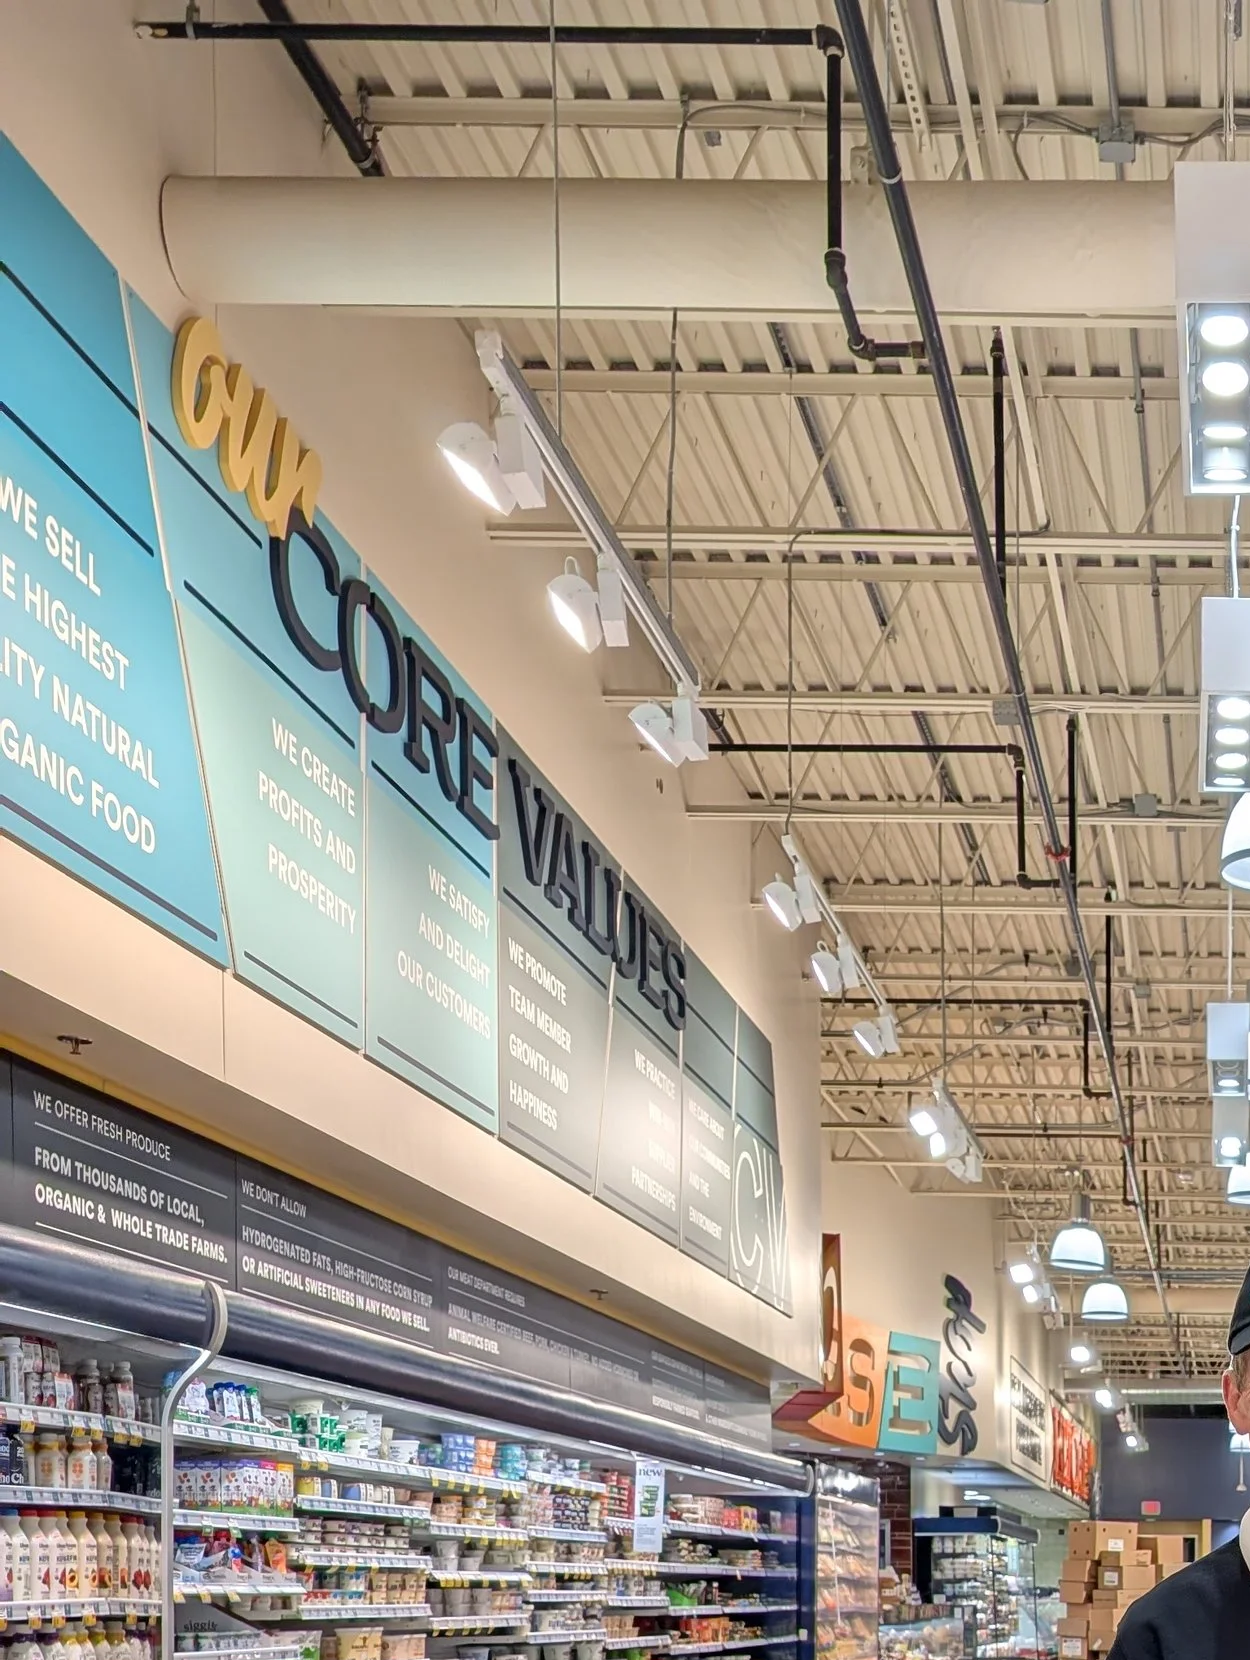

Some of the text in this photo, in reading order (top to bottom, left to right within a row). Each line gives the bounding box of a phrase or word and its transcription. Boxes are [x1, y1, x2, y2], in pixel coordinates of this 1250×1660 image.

[0, 476, 101, 597] WE SELL
[24, 573, 129, 691] HIGHEST
[0, 636, 160, 789] ITY NATURAL
[269, 505, 687, 1031] CORE VALUES
[271, 717, 356, 817] WE CREATE
[91, 779, 155, 854] FOOD
[258, 769, 356, 875] PROFITS AND
[268, 843, 356, 934] PROSPERITY
[428, 865, 490, 939] WE SATISFY
[418, 913, 490, 989] AND DELIGHT
[508, 937, 567, 1006] WE PROMOTE
[397, 950, 490, 1040] OUR CUSTOMERS
[509, 985, 571, 1054] TEAM MEMBER
[509, 1033, 569, 1095] GROWTH AND
[33, 1090, 171, 1161] WE OFFER FRESH PRODUCE
[509, 1080, 558, 1131] HAPPINESS
[35, 1146, 204, 1228] FROM THOUSANDS OF LOCAL,
[35, 1183, 228, 1263] ORGANIC & WHOLE TRADE FARMS.
[241, 1179, 307, 1218] WE DON'T ALLOW
[242, 1225, 311, 1265] HYDROGENATED
[312, 1251, 334, 1277] FATS,
[334, 1259, 392, 1294] HIGH-FRUCTOSE
[242, 1256, 255, 1275] OR
[257, 1261, 303, 1290] ARTIFICIAL
[304, 1277, 354, 1307] SWEETENERS
[355, 1294, 364, 1310] IN
[365, 1298, 380, 1316] ANY
[381, 1303, 400, 1322] FOOD
